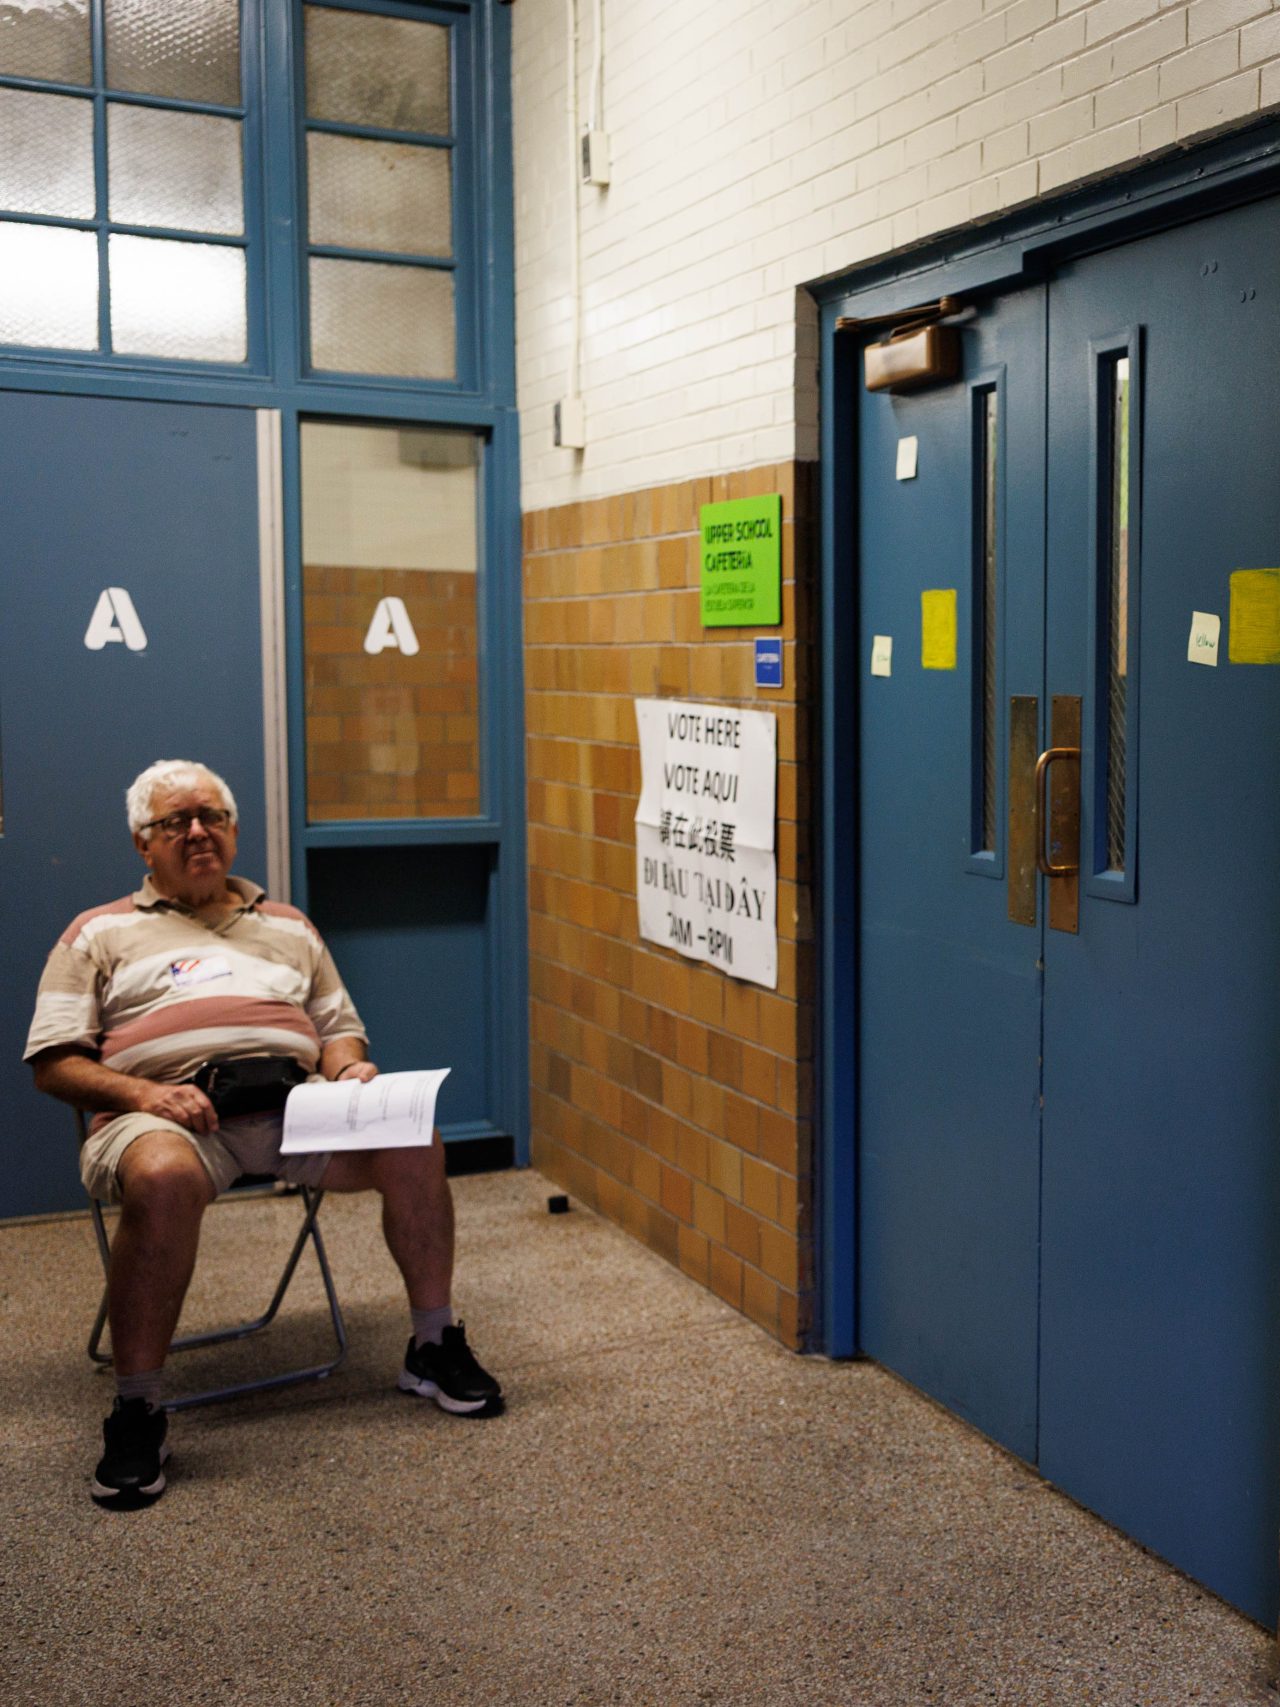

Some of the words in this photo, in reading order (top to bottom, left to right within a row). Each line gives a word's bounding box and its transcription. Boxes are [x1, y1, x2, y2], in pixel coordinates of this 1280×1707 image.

[705, 523, 733, 544] UPPER
[736, 518, 773, 541] SCHOOL
[705, 550, 752, 571] CAFETERIA
[84, 587, 148, 651] A
[363, 596, 420, 656] A
[667, 712, 702, 743] VOTE
[704, 717, 741, 748] HERE
[663, 762, 699, 795] VOTE
[702, 769, 739, 804] AQUI
